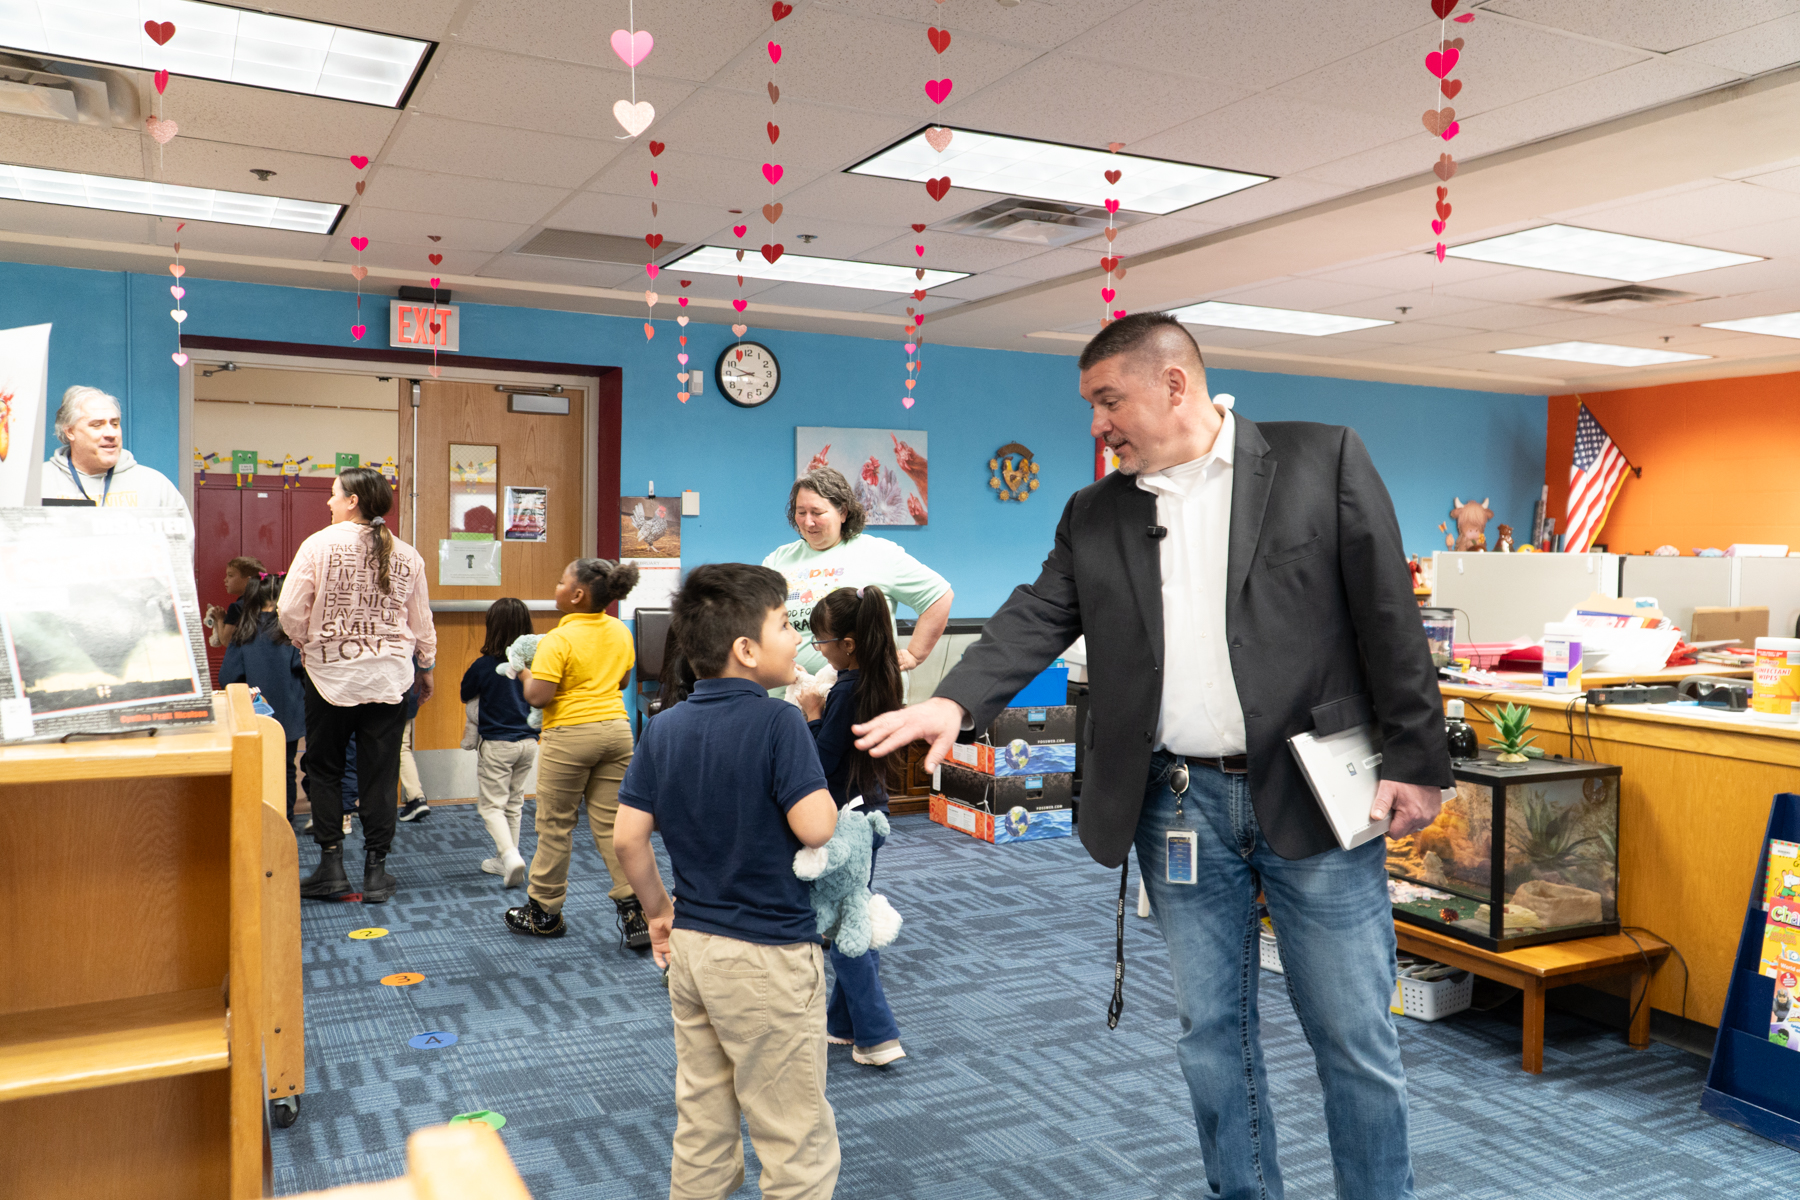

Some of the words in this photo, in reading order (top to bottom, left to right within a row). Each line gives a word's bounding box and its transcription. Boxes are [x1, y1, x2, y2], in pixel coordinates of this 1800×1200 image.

[398, 305, 452, 346] EXIT
[328, 543, 361, 555] TAKE
[390, 551, 412, 564] ASY
[328, 553, 357, 568] BE
[363, 556, 411, 578] KND
[324, 582, 368, 592] LAUGH
[326, 568, 367, 583] LIVE
[372, 571, 408, 592] LFE
[323, 592, 352, 608] BE
[358, 593, 403, 610] NICE
[322, 607, 365, 621] HAVE
[369, 608, 400, 622] FUN
[800, 607, 814, 617] FO
[321, 639, 406, 664] LOVE
[395, 975, 411, 983] 3
